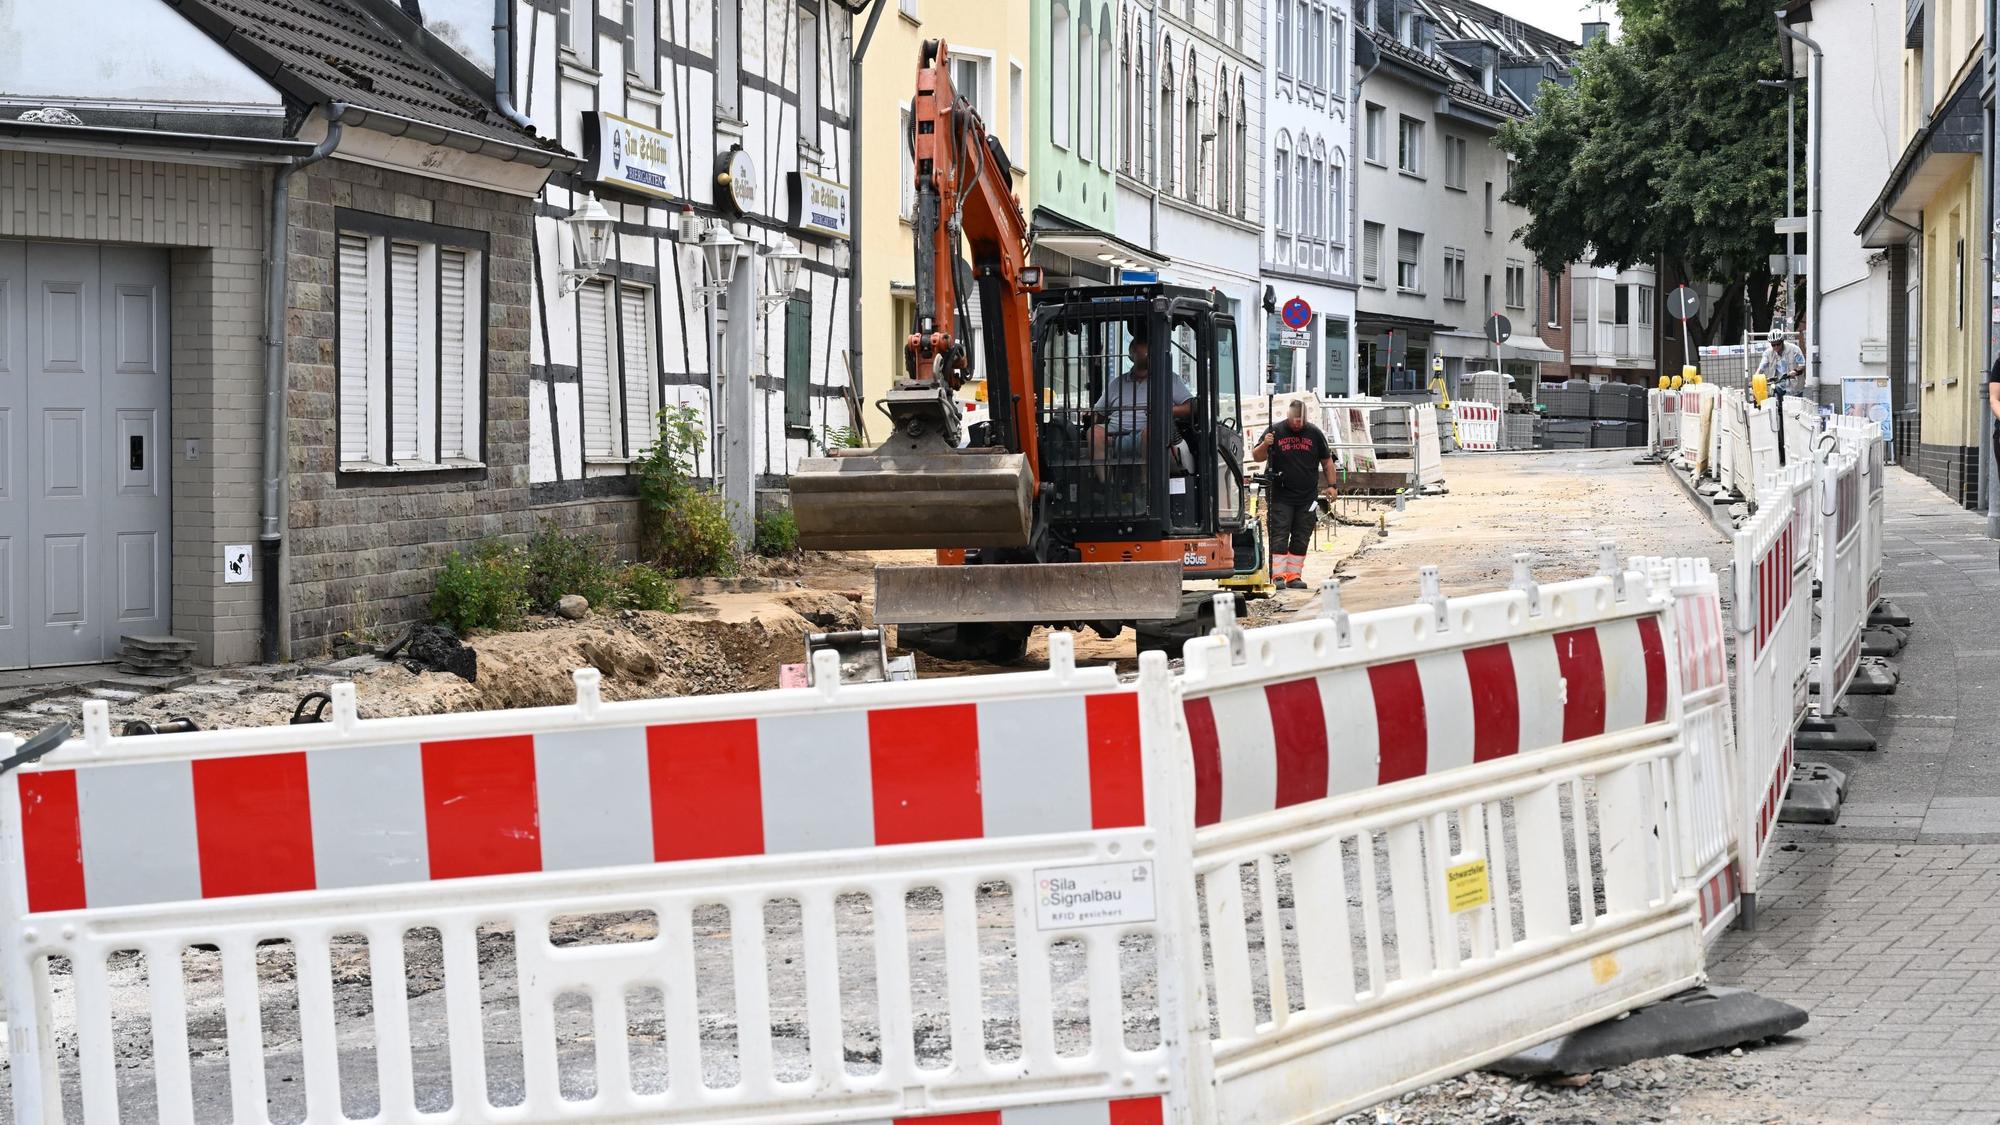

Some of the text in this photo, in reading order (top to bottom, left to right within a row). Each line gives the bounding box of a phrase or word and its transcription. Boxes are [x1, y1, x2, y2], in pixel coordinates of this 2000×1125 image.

[625, 128, 638, 157] Im
[628, 167, 663, 187] BIERGARTEN
[1050, 878, 1076, 892] Sila
[1050, 889, 1122, 907] Signalbau
[1052, 909, 1123, 921] RFID gesichert
